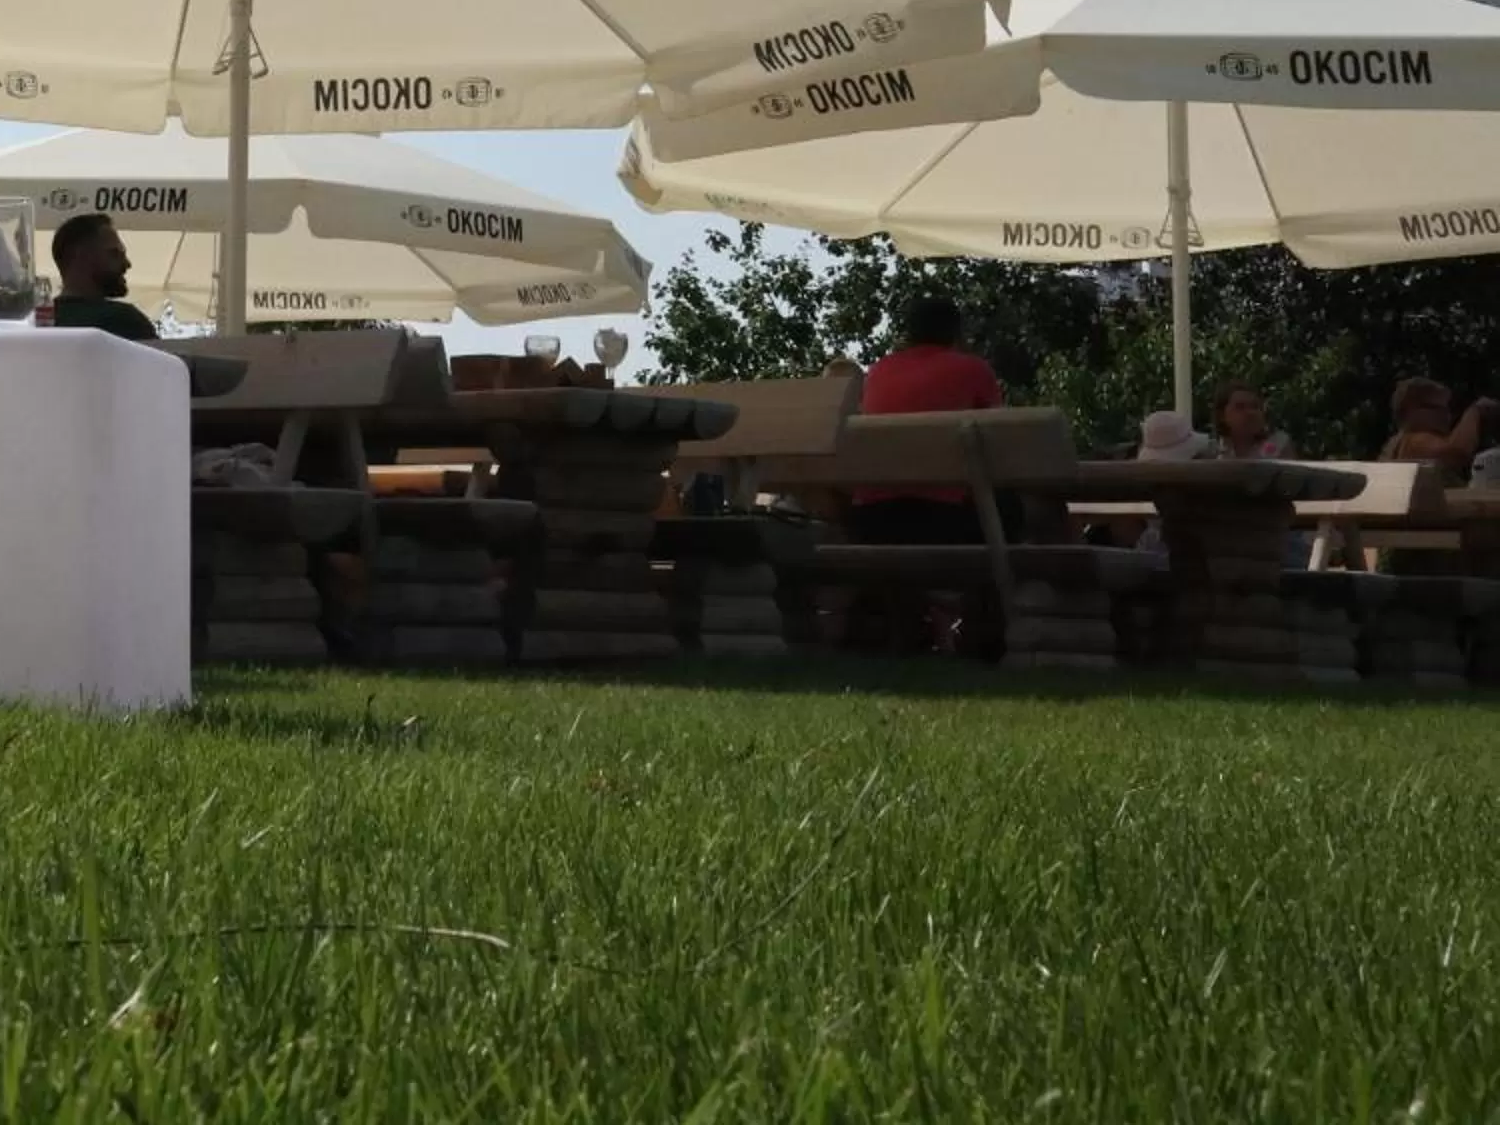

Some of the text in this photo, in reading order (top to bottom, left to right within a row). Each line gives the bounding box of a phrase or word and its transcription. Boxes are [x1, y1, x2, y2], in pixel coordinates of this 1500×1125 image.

[1288, 49, 1434, 86] OKOCIM
[805, 68, 916, 115] OKOCIM
[95, 187, 188, 213] OKOCIM
[447, 208, 524, 243] OKOCIM
